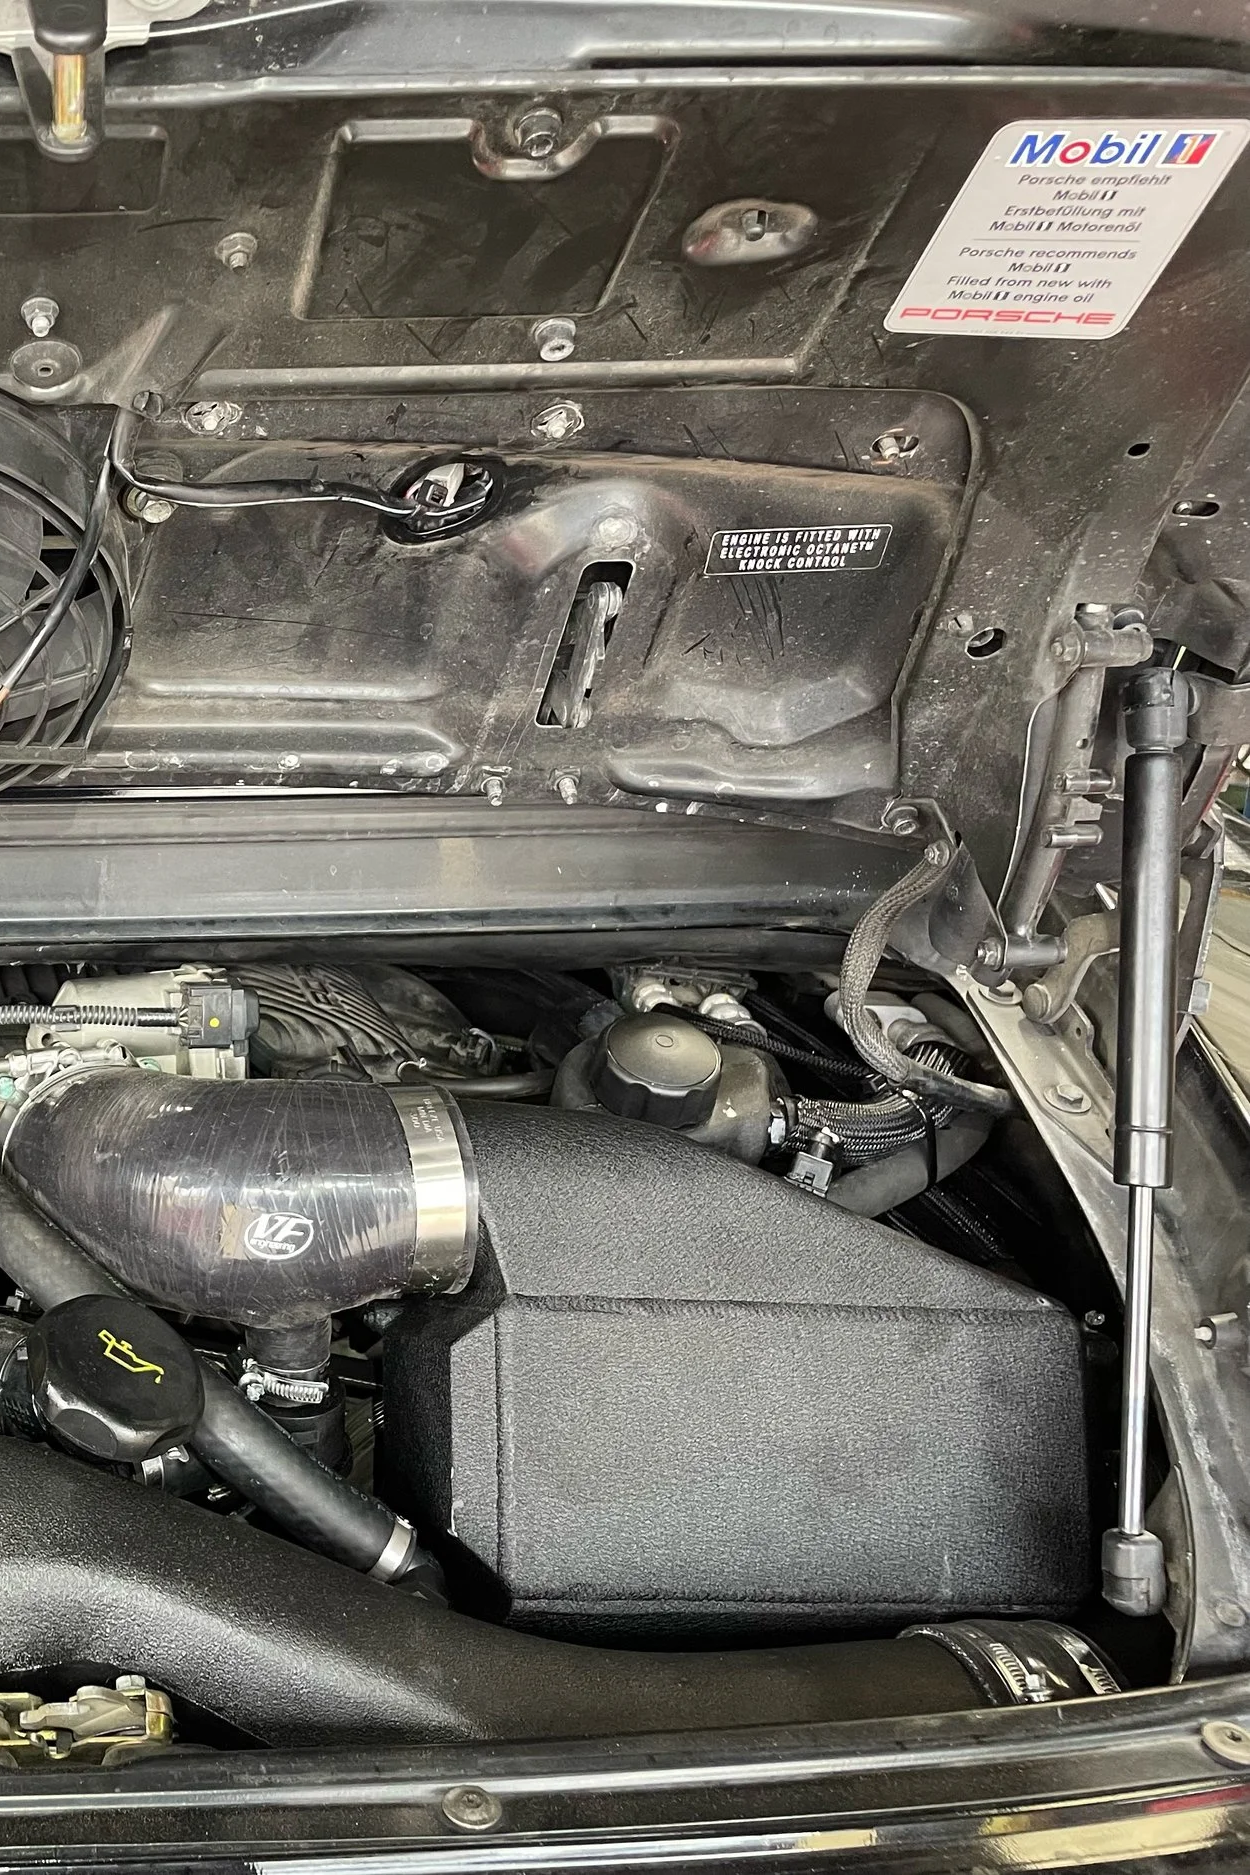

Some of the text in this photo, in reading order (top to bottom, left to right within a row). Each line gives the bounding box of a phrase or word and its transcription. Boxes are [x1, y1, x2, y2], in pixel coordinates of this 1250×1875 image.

[1009, 133, 1162, 165] Mobil
[1016, 174, 1172, 187] Porsche empfiehlt
[1052, 190, 1099, 201] Mobil
[1003, 204, 1146, 219] Erstbefüllung mit
[988, 220, 1035, 232] Mobil
[1056, 221, 1143, 232] Motorenöl
[958, 247, 1138, 260] Porsche recommends
[1007, 262, 1053, 273] Mobil
[946, 276, 1113, 290] Filled from new with
[946, 290, 991, 301] Mobil
[1013, 292, 1070, 305] engine
[1073, 292, 1095, 304] oil
[900, 308, 1117, 325] PORSCHE
[721, 528, 882, 547] ENGINE IS FITTED WITH
[719, 544, 801, 560] ELECTRONIC
[738, 554, 847, 572] KNOCK CONTROL
